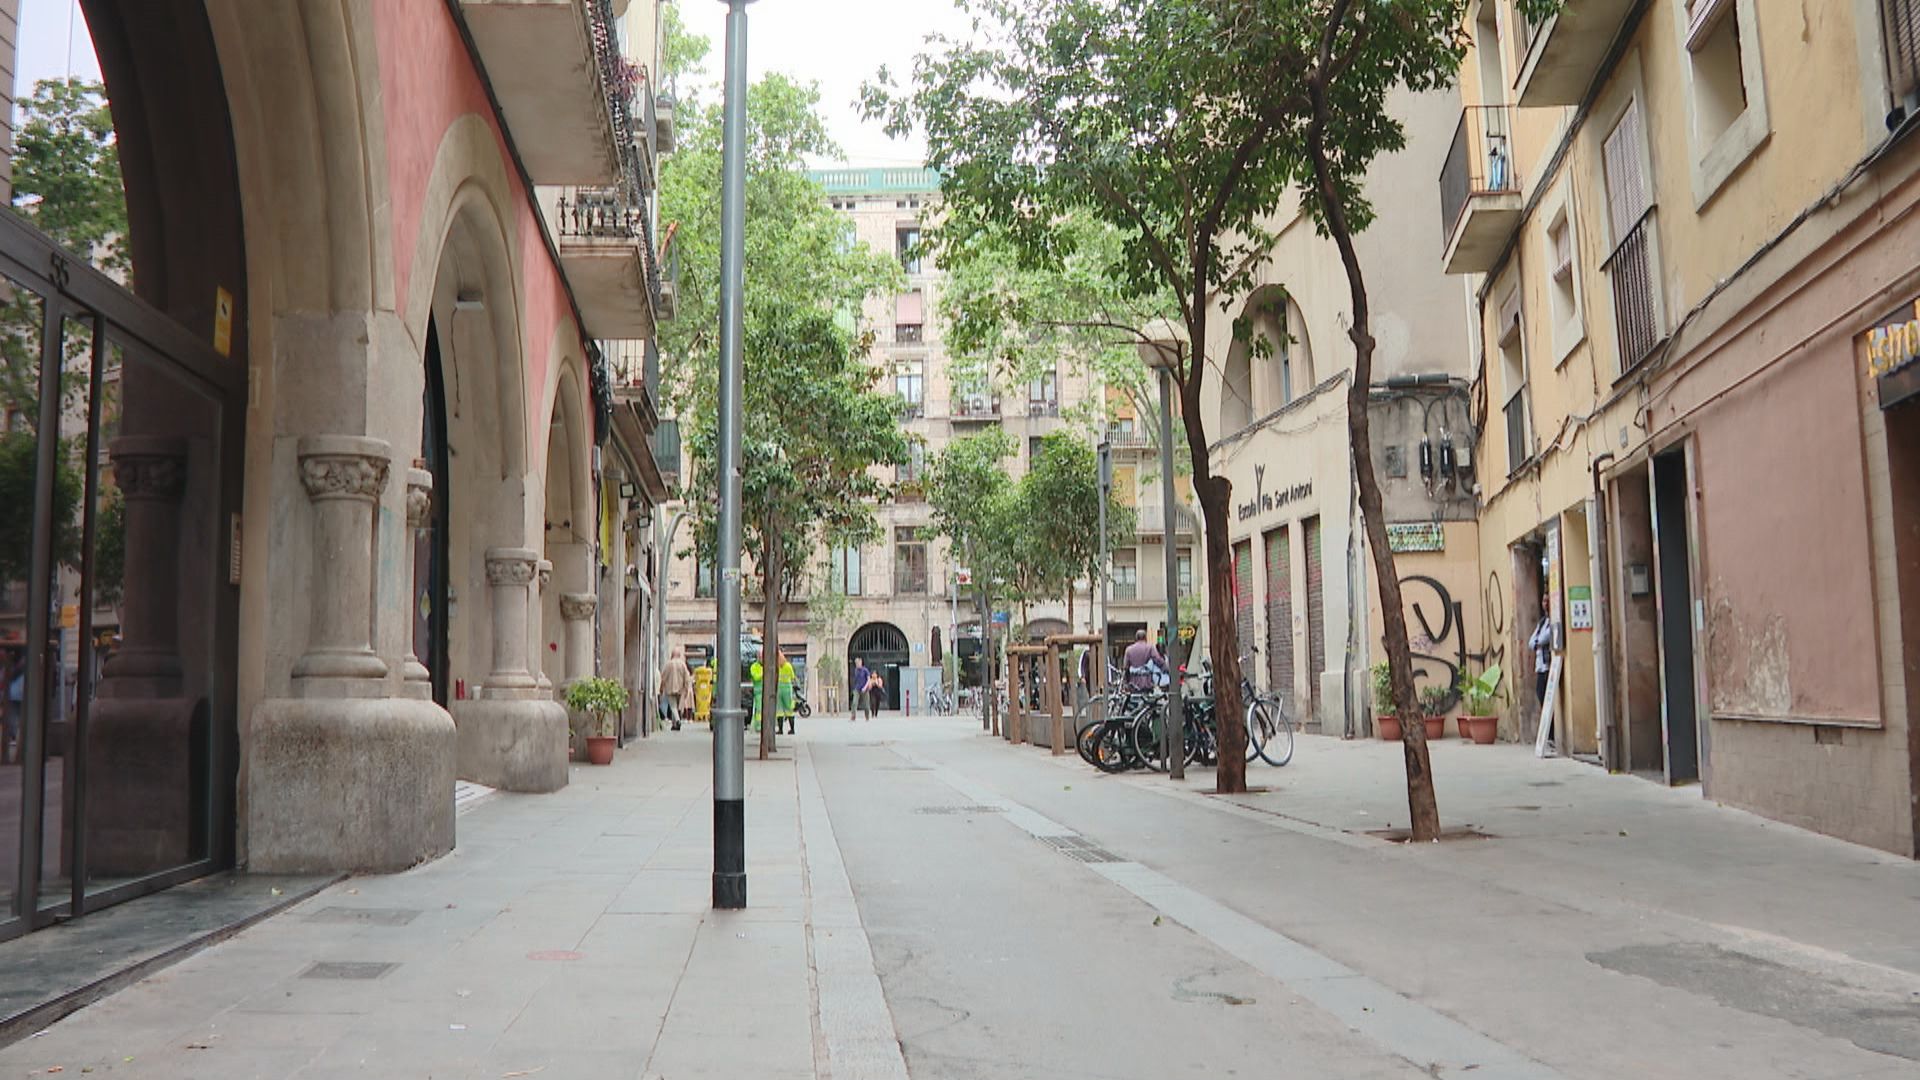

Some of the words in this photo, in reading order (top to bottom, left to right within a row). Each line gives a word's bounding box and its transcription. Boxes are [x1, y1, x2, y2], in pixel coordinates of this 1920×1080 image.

[49, 252, 69, 286] 55
[1238, 498, 1256, 521] Escola
[1262, 493, 1272, 511] Pia
[1275, 488, 1289, 508] Sant
[1290, 477, 1312, 502] Antoni
